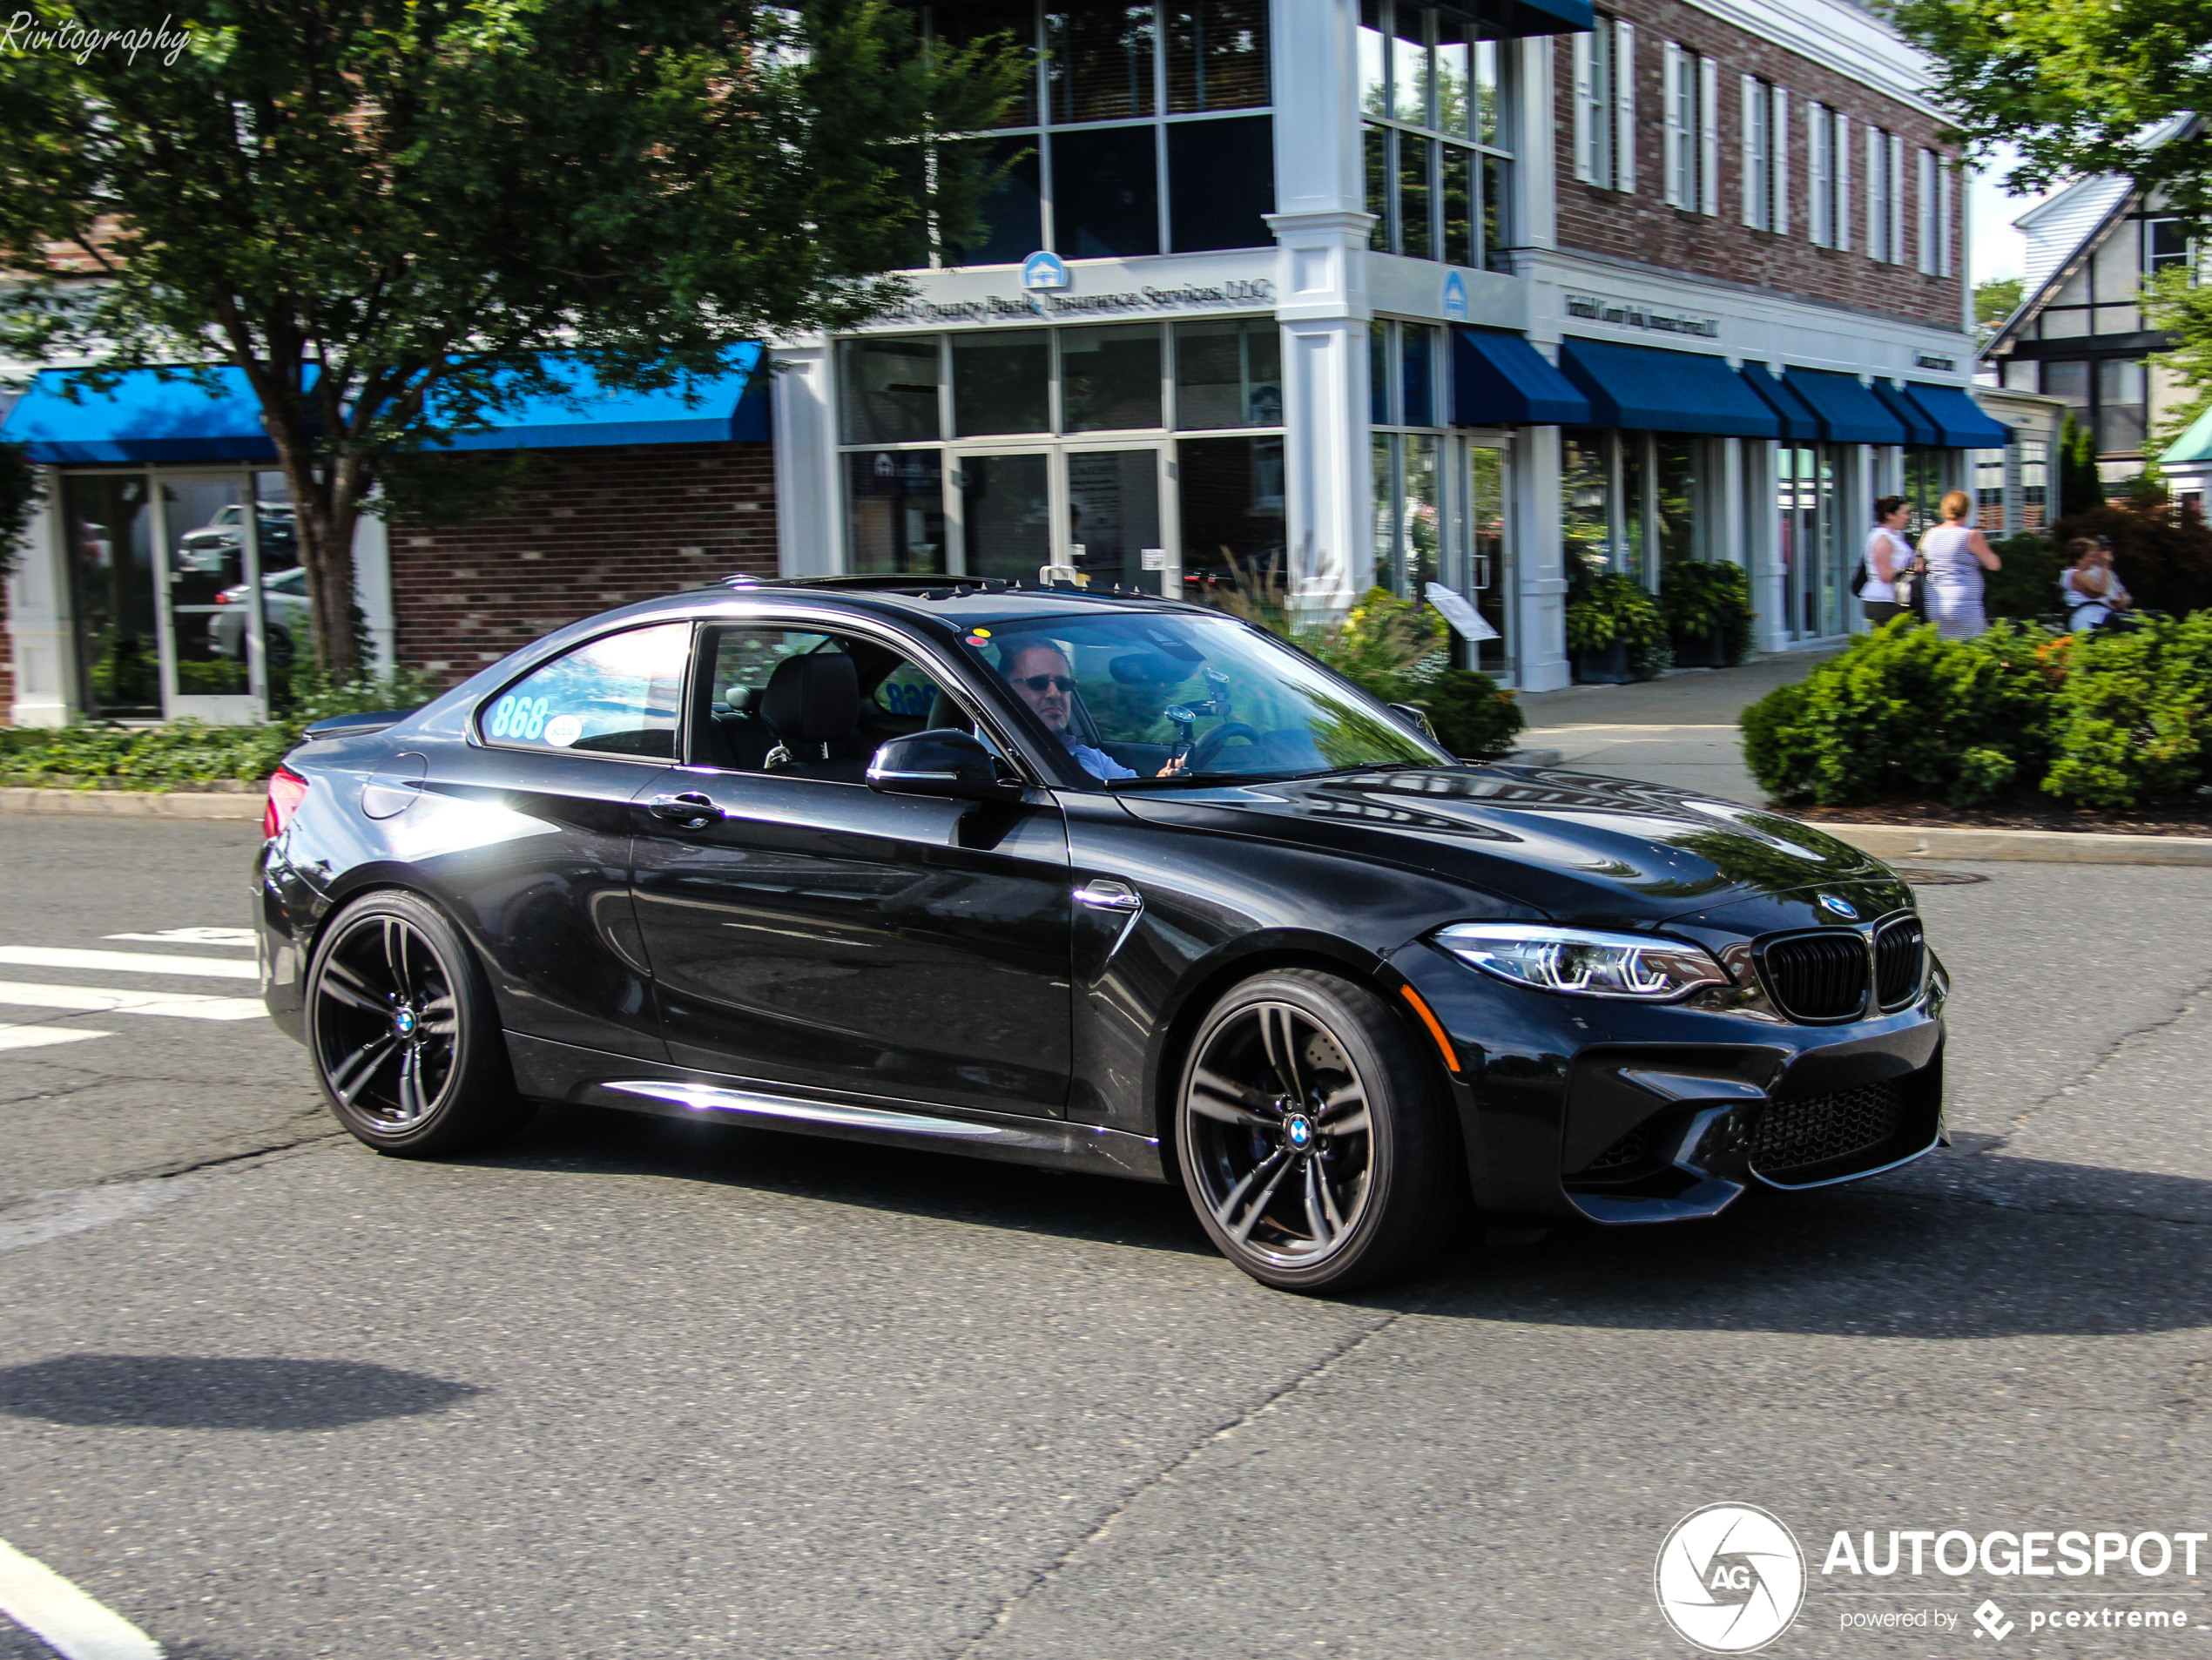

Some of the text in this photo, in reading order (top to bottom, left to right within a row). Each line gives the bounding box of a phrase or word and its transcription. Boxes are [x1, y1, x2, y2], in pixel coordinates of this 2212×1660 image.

[913, 299, 988, 321] County
[986, 293, 1041, 314] Bank
[1043, 292, 1142, 312] Insurance
[491, 695, 550, 739] 868
